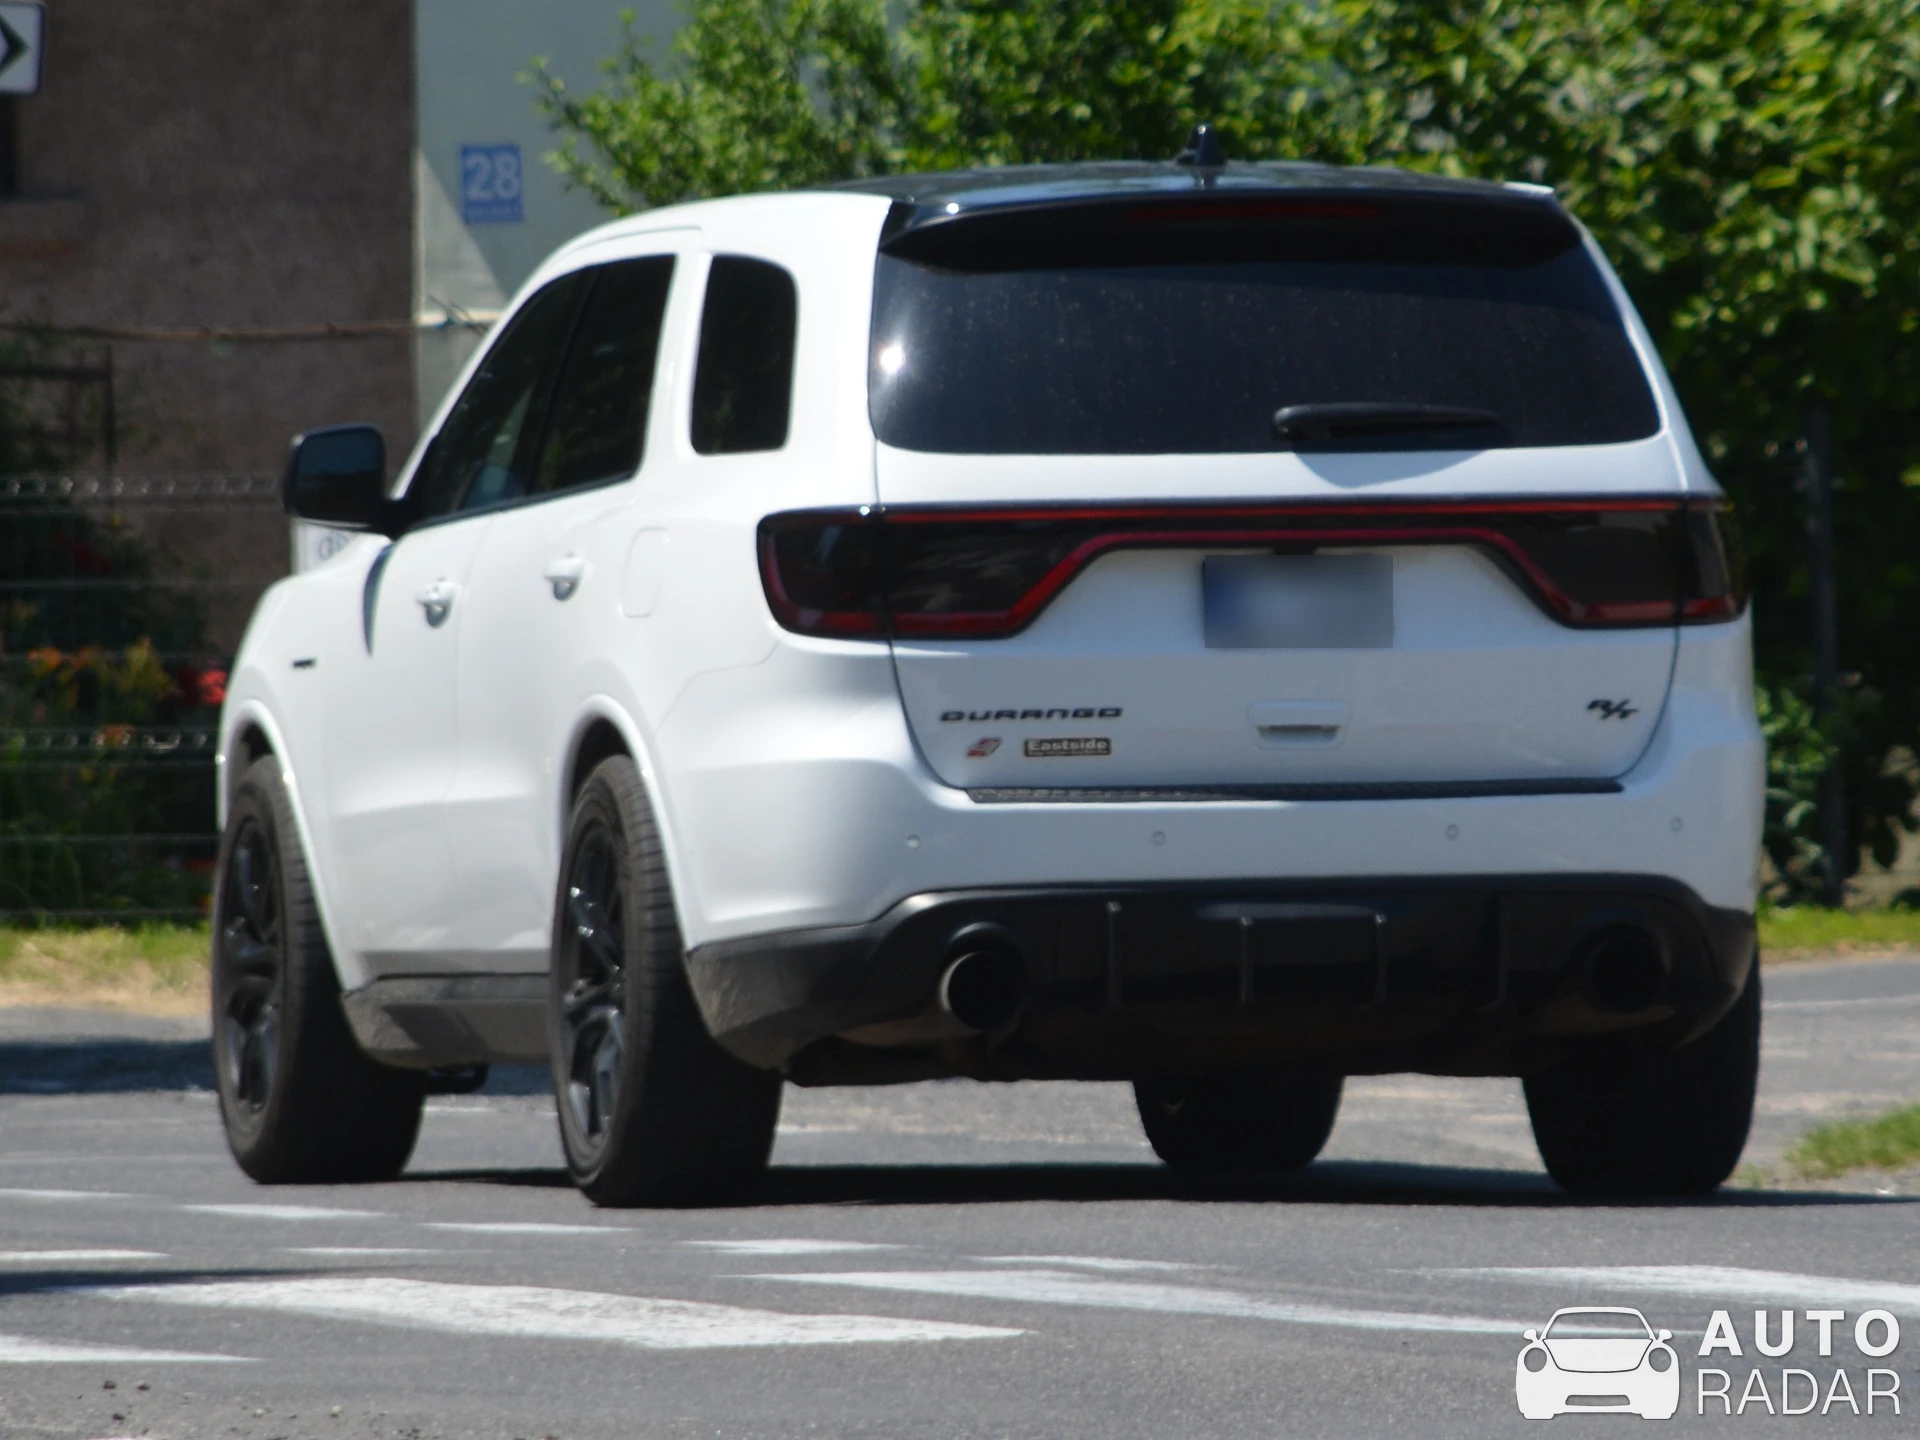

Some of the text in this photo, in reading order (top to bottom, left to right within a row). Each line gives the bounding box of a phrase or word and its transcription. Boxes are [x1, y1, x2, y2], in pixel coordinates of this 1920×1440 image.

[466, 152, 519, 199] 28
[940, 707, 1123, 722] DURANGO
[1027, 738, 1108, 751] Eastside
